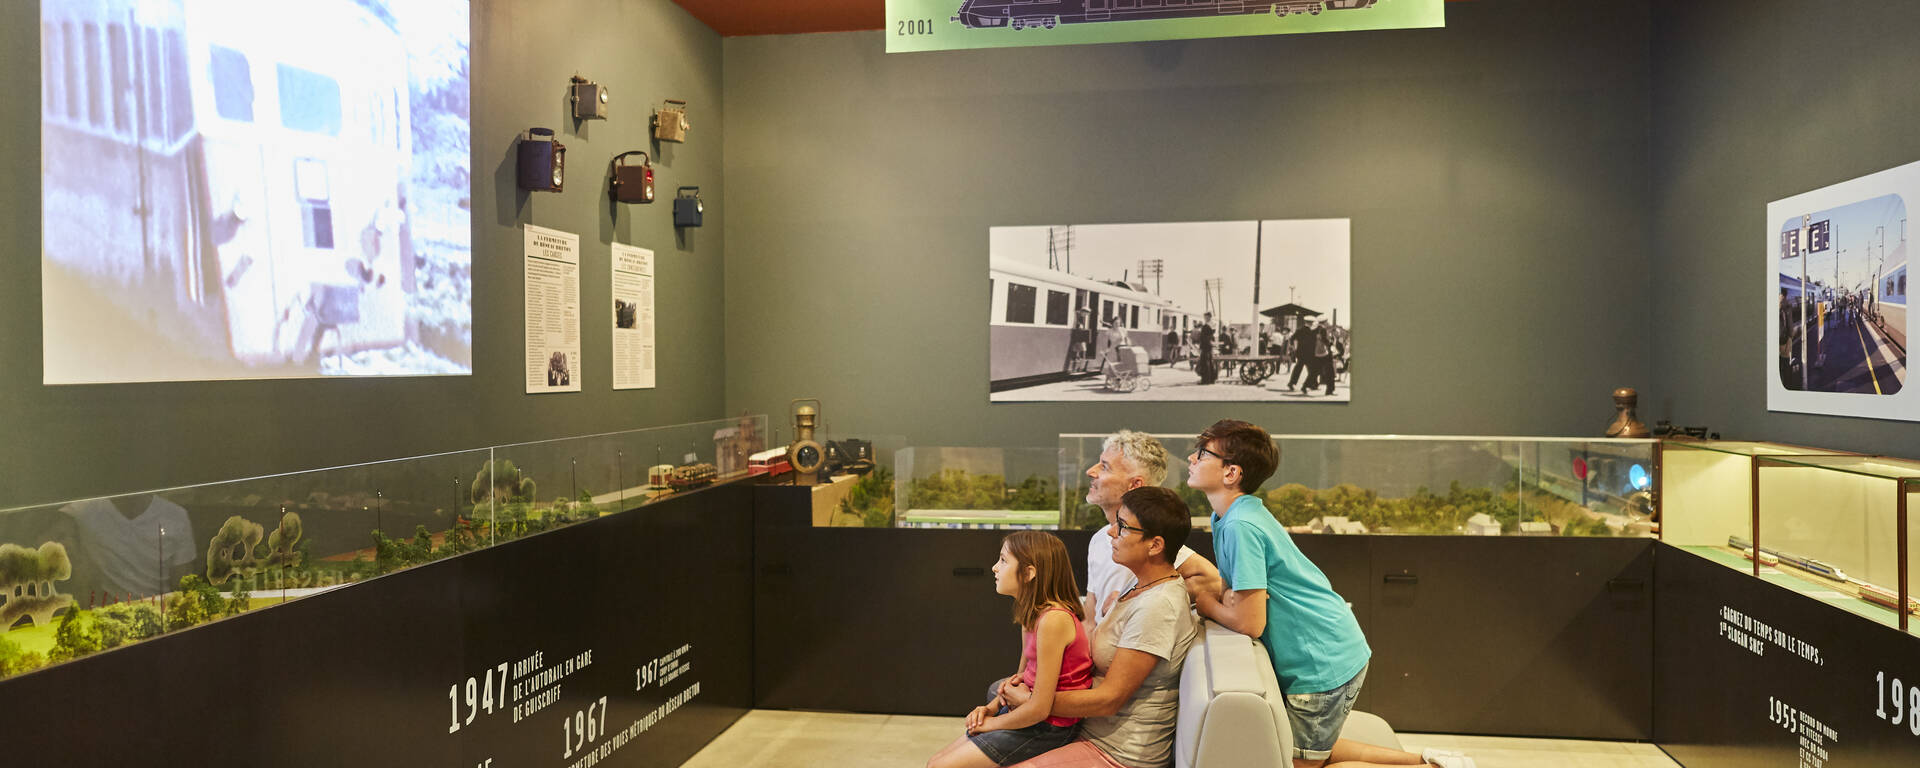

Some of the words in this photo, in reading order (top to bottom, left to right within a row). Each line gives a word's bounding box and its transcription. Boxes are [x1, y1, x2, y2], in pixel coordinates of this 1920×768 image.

[898, 18, 934, 36] 2001
[1723, 605, 1744, 628] GAGNEZ
[1744, 615, 1752, 632] DU
[1753, 619, 1773, 642] TEMPS
[1774, 628, 1786, 649] SUR
[1787, 635, 1796, 653] LE
[1797, 639, 1819, 665] TEMPS
[1728, 625, 1748, 649] SLOGAN
[1749, 636, 1764, 657] SNCF
[513, 650, 543, 680] ARRIVÉE
[514, 682, 523, 702] DE
[525, 663, 563, 696] L'AUTORAIL
[565, 657, 574, 676] EN
[576, 649, 592, 670] GARE
[636, 658, 658, 691] 1967
[449, 662, 508, 734] 1947
[514, 703, 523, 724] DE
[525, 684, 561, 717] GUISCRIFF
[1769, 696, 1797, 733] 1955
[564, 696, 607, 760] 1967
[600, 740, 612, 760] DES
[612, 729, 629, 751] VOIES
[629, 709, 658, 740] MÉTRIQUES
[658, 704, 666, 720] DU
